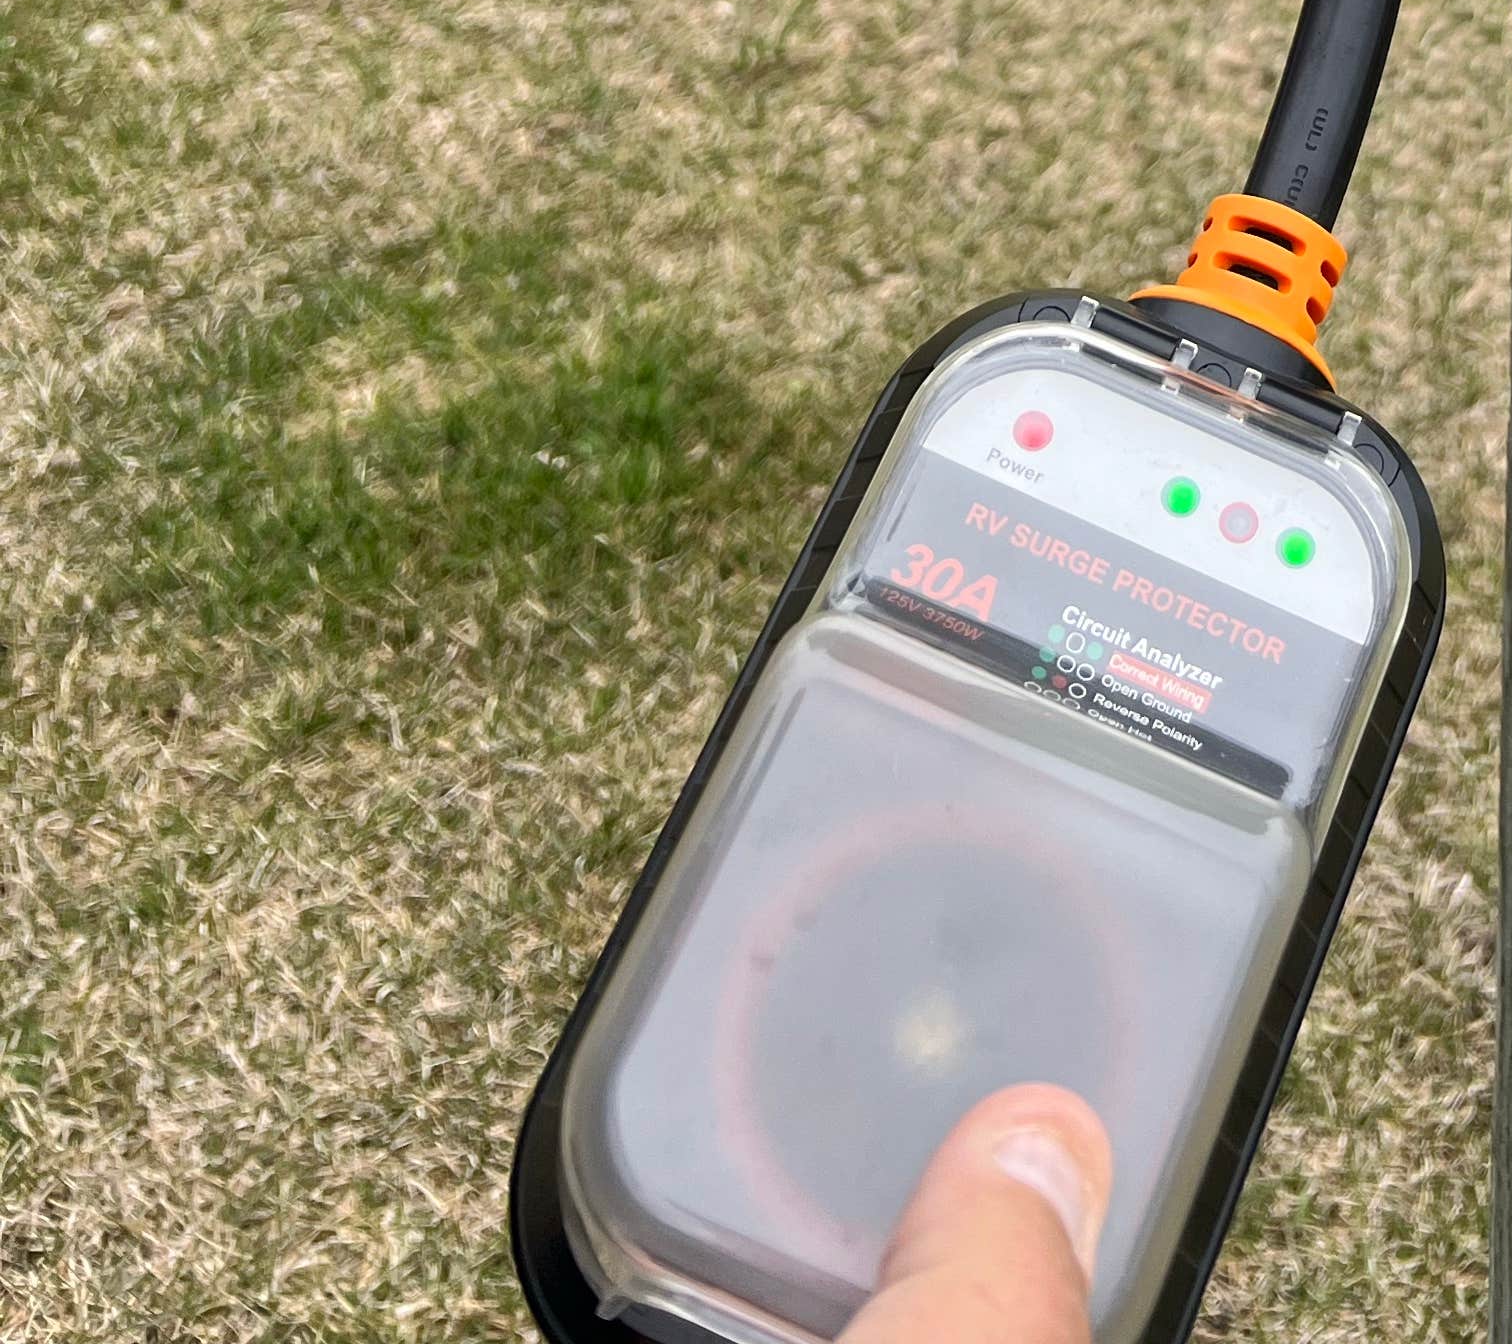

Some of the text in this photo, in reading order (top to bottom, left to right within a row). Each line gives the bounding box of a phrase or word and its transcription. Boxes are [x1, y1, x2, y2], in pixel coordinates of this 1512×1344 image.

[1304, 107, 1328, 152] (UL)
[986, 448, 1045, 485] Power
[890, 544, 998, 623] 30A
[965, 502, 1286, 665] RV SURGE PROTECTOR
[1062, 605, 1223, 689] Circuit Analyzer
[1101, 674, 1192, 723] Open Ground
[1109, 654, 1204, 709] Correct Wiring
[1093, 693, 1203, 751] Reverse Polarity
